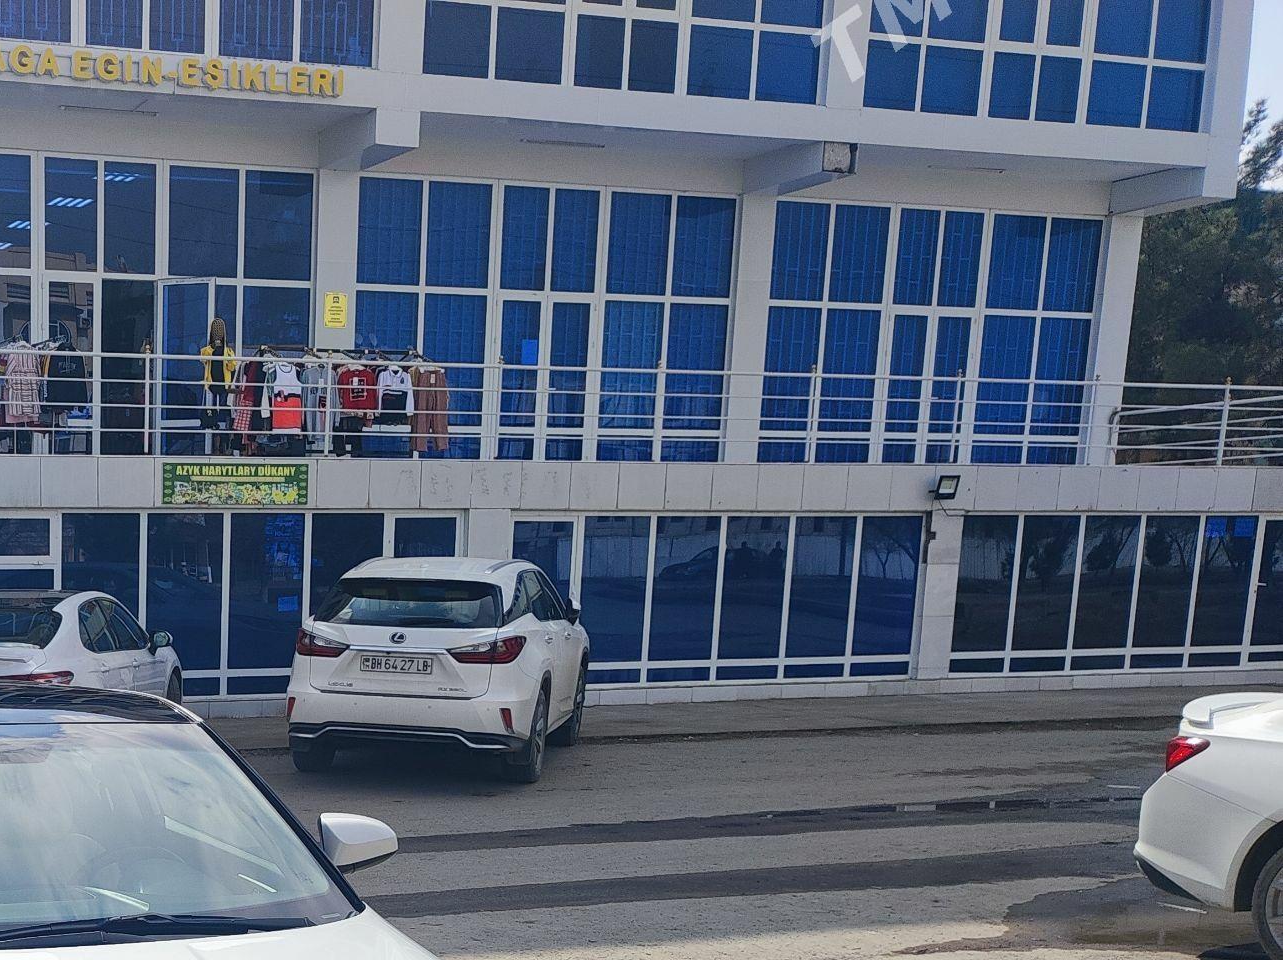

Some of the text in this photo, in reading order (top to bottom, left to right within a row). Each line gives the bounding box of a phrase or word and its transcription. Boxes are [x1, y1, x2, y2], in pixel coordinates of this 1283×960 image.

[176, 465, 296, 477] AZYK HARYTLARY DÜKANY
[370, 657, 383, 670] BH
[384, 658, 398, 671] 64
[399, 659, 415, 672] 27
[416, 660, 428, 672] LB
